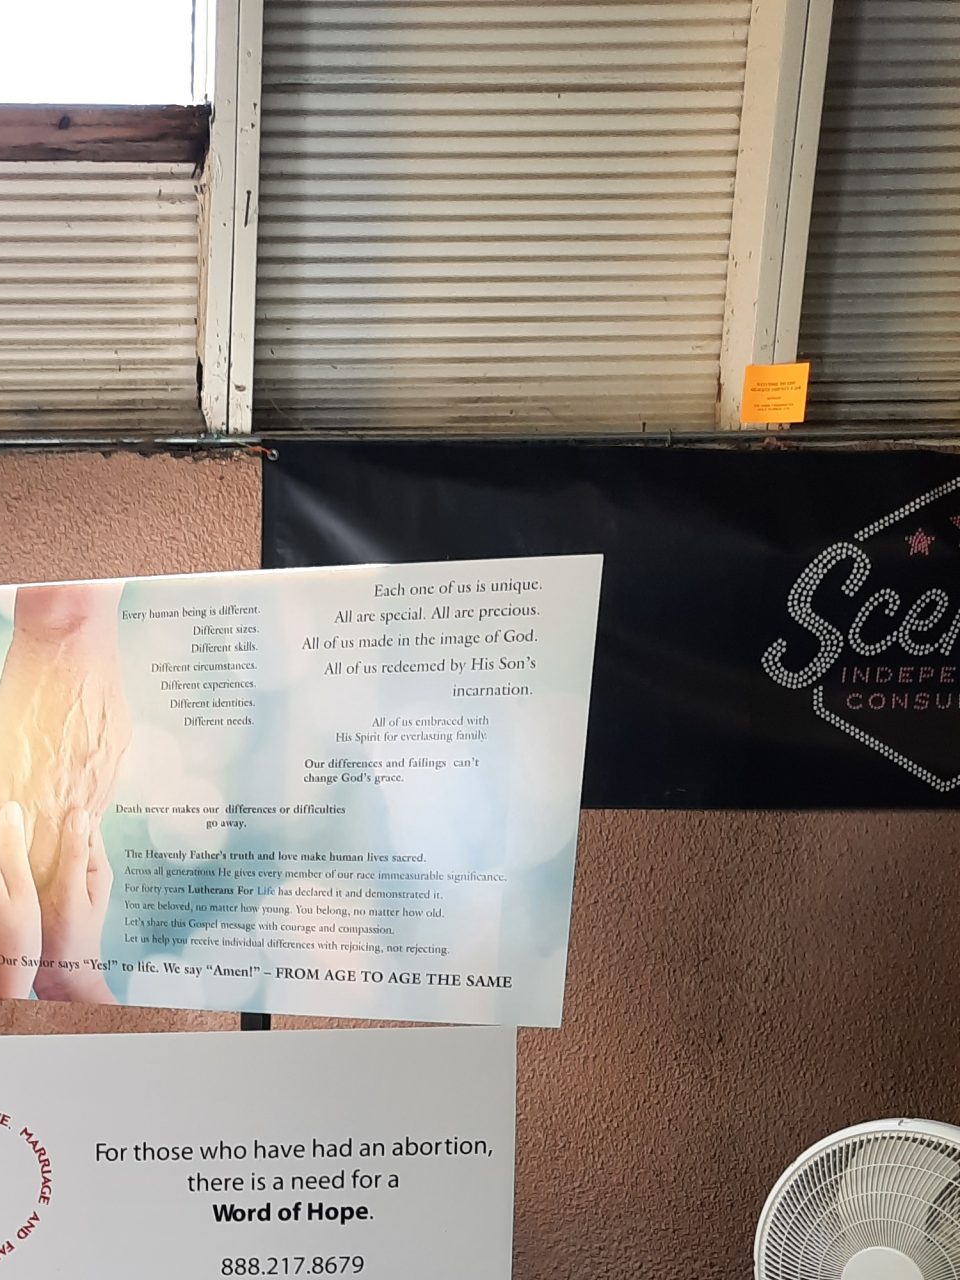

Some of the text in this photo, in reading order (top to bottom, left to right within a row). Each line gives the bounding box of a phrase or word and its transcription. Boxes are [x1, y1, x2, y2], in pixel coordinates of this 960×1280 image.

[374, 577, 543, 598] Each one of us is unique.
[334, 602, 540, 626] All are special. All are precious.
[21, 953, 57, 971] Savior
[57, 960, 80, 973] says
[83, 958, 118, 971] "Yes!"
[121, 962, 134, 972] to
[137, 959, 159, 973] life.
[162, 962, 181, 974] We
[184, 966, 203, 978] say
[206, 964, 261, 978] "Amen!"
[275, 967, 320, 981] FROM
[323, 969, 357, 982] AGE
[360, 970, 384, 984] TO
[387, 971, 422, 985] AGE
[425, 973, 462, 987] THE
[465, 974, 513, 989] SAME
[96, 1136, 493, 1162] For those who have had an abortion,
[187, 1168, 399, 1193] there is a need for a
[212, 1201, 374, 1226] Word of Hope.
[220, 1255, 365, 1276] 888.217.8679
